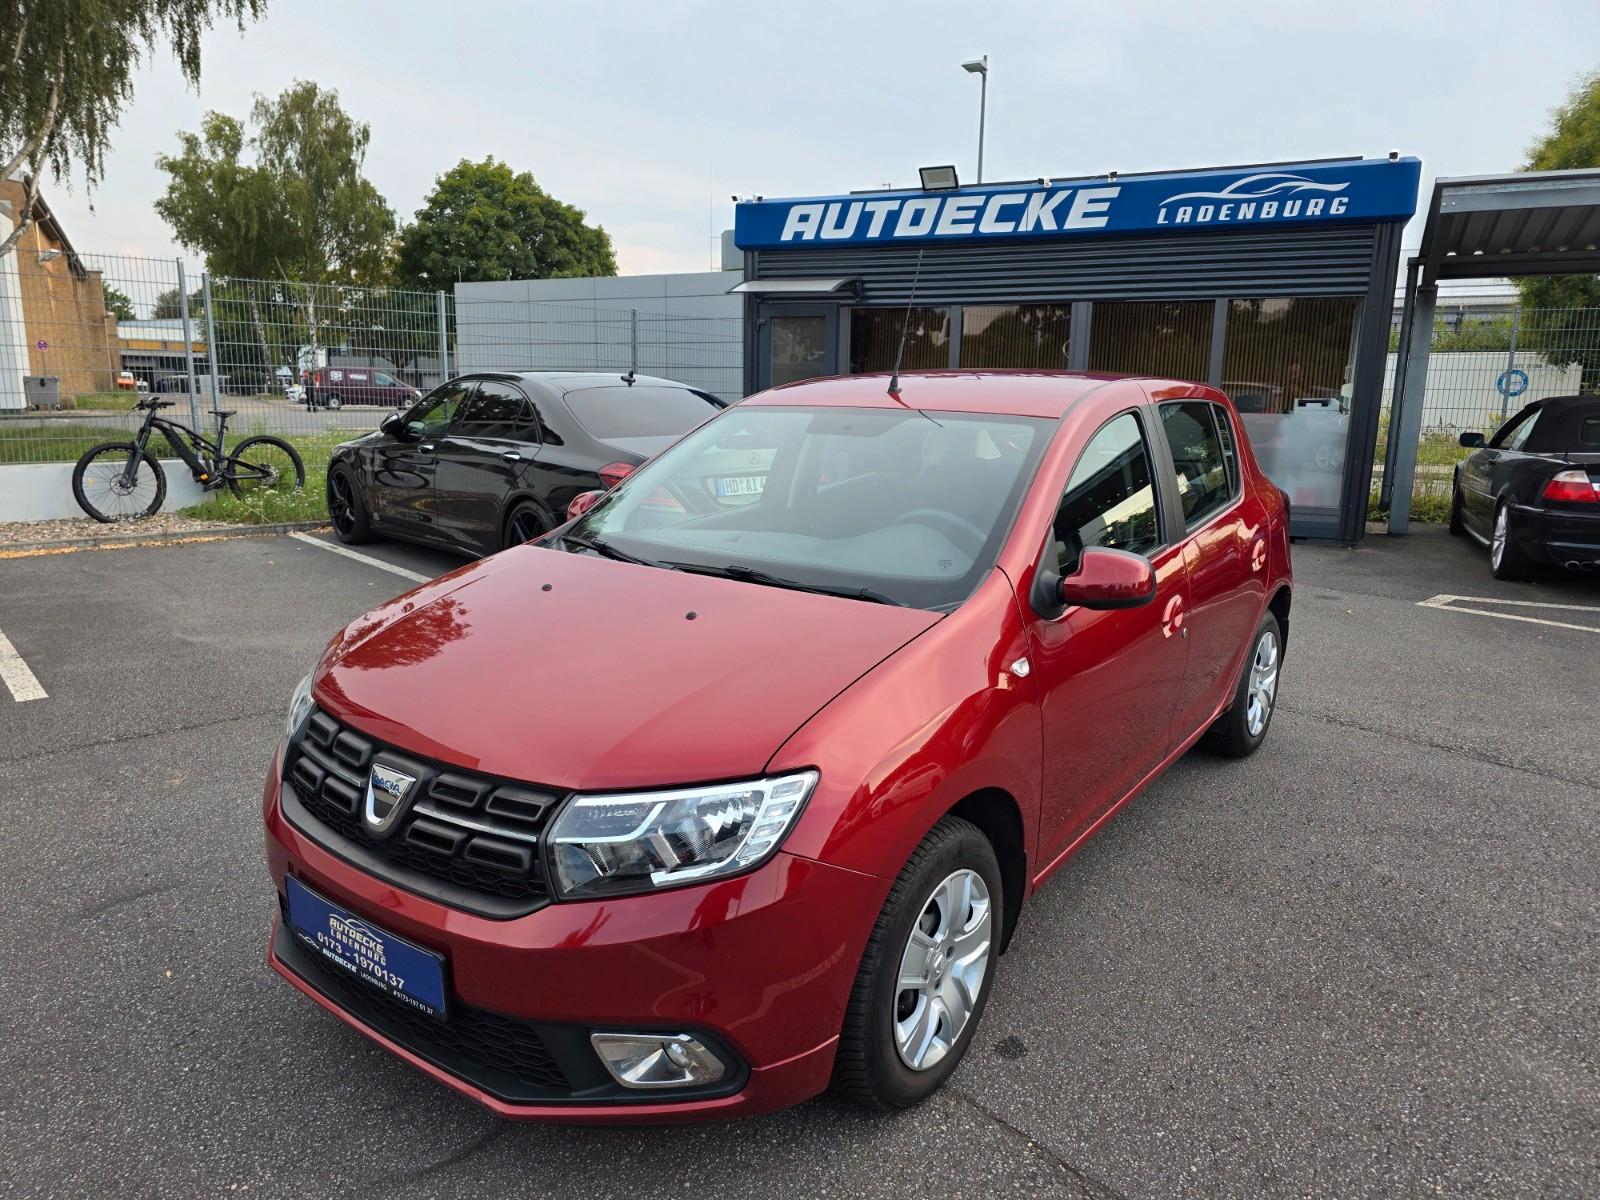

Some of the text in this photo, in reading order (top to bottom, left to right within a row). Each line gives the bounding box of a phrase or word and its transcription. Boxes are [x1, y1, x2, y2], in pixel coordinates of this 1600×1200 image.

[780, 186, 1121, 241] AUTOECKE
[1156, 197, 1350, 225] LADENBURG
[725, 479, 739, 494] HD
[371, 773, 401, 795] DACIA
[330, 917, 384, 954] AUTOECKE
[330, 928, 386, 966] LADENBURG
[316, 931, 342, 954] 0173
[353, 952, 405, 990] 1970137
[322, 947, 357, 973] AUTOECKE
